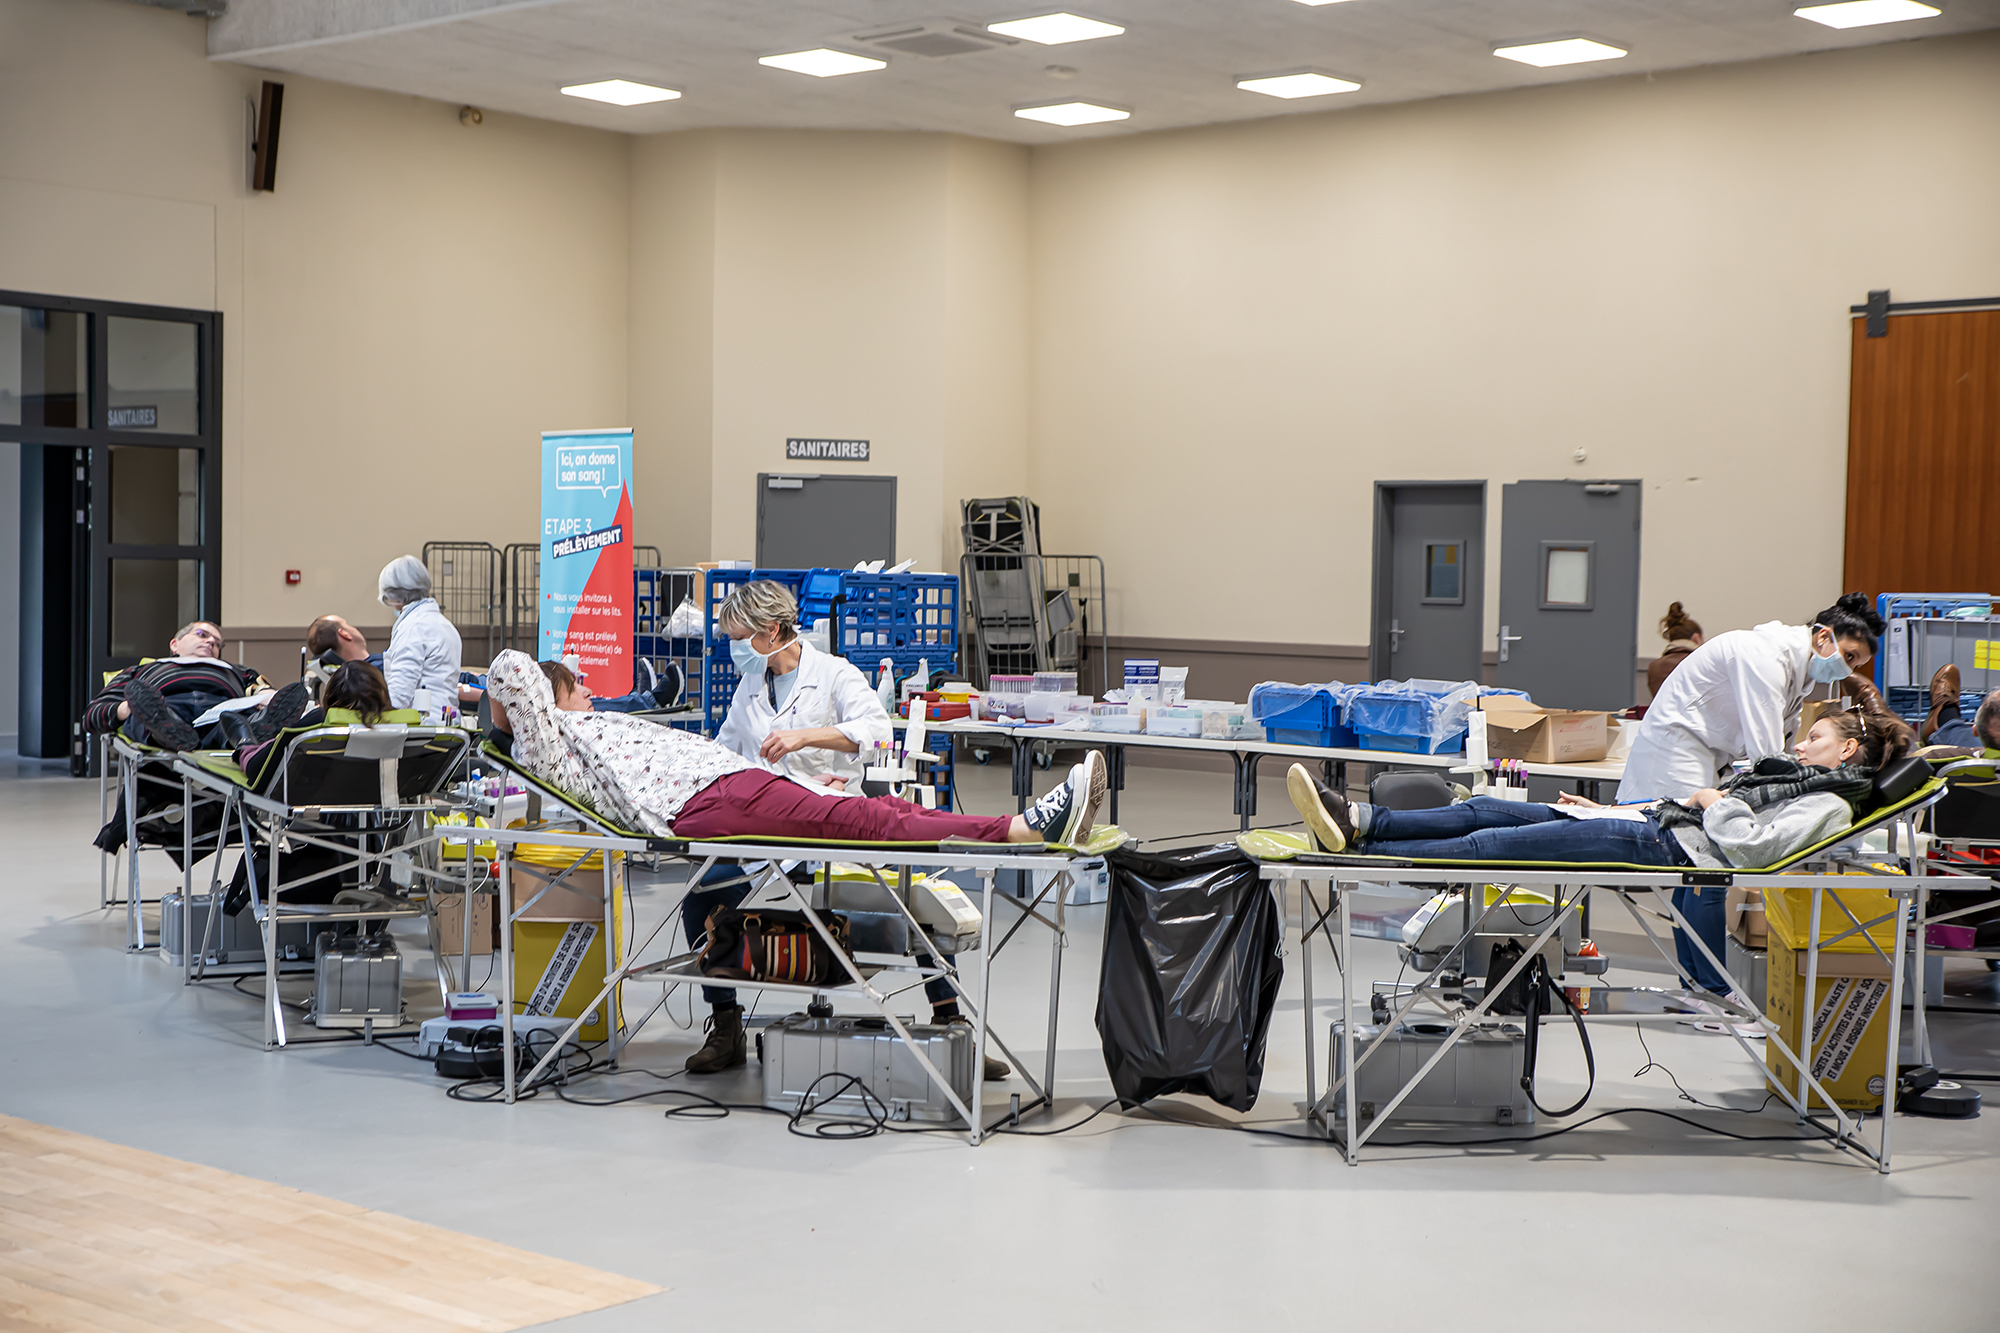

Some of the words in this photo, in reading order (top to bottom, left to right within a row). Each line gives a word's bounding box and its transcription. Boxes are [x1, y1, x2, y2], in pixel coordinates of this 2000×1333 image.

[107, 408, 156, 426] SANITAIRES
[789, 440, 867, 458] SANITAIRES
[561, 452, 574, 468] Ici,
[575, 455, 587, 466] on
[588, 451, 616, 466] donne
[561, 471, 577, 482] son
[578, 470, 600, 485] sang
[545, 518, 582, 535] ETAPE
[585, 518, 592, 535] 3
[553, 528, 621, 558] PRÉLÈVEMENT
[553, 592, 567, 602] Nous
[568, 593, 583, 602] vous
[584, 593, 607, 603] invitons
[553, 606, 566, 614] vous
[566, 605, 591, 615] installer
[592, 607, 602, 616] sur
[602, 606, 611, 616] les
[552, 629, 567, 639] Votre
[569, 631, 584, 641] sang
[585, 632, 594, 640] est
[614, 645, 622, 655] de
[1827, 983, 1845, 1008] WASTE
[1848, 990, 1866, 1012] SOINS
[1860, 981, 1887, 1019] INFECTIEUX
[1843, 1009, 1855, 1022] DE
[1823, 1018, 1850, 1058] D'ACTIVITES
[1846, 1017, 1867, 1046] RISQUES
[1831, 1050, 1849, 1072] MOUS
[1827, 1069, 1838, 1079] ET
